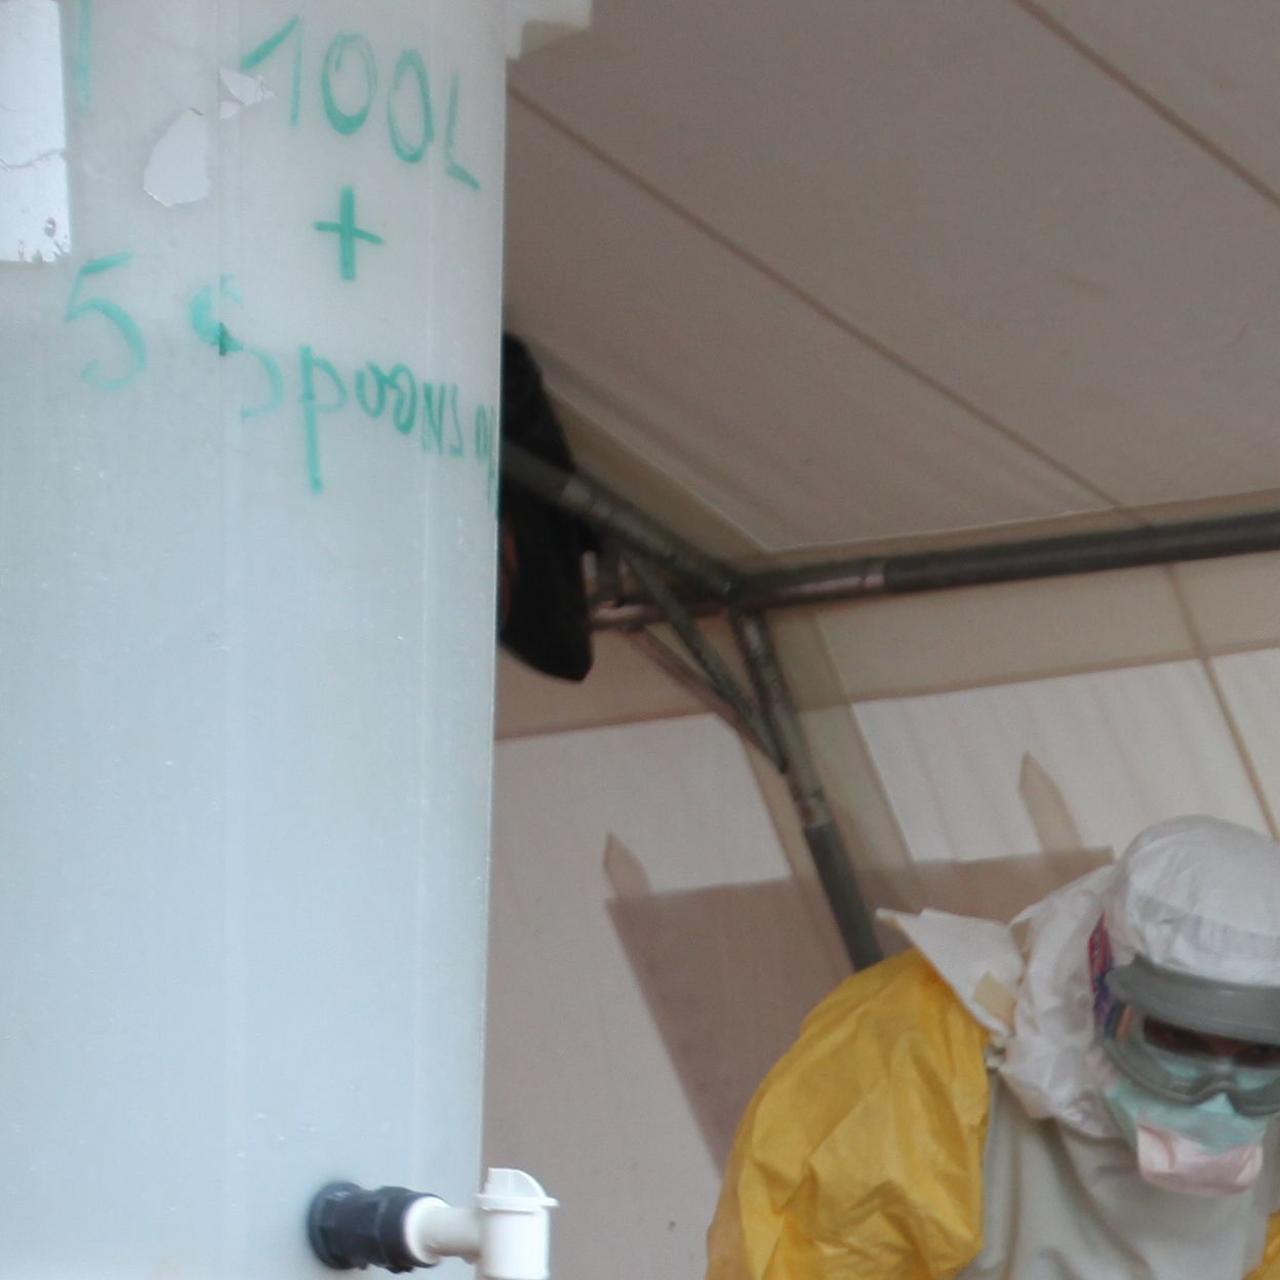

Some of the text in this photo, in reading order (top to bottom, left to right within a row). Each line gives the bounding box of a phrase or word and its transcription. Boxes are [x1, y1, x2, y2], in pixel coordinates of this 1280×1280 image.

[240, 15, 480, 192] 100L
[313, 185, 384, 282] +
[64, 252, 147, 391] 5
